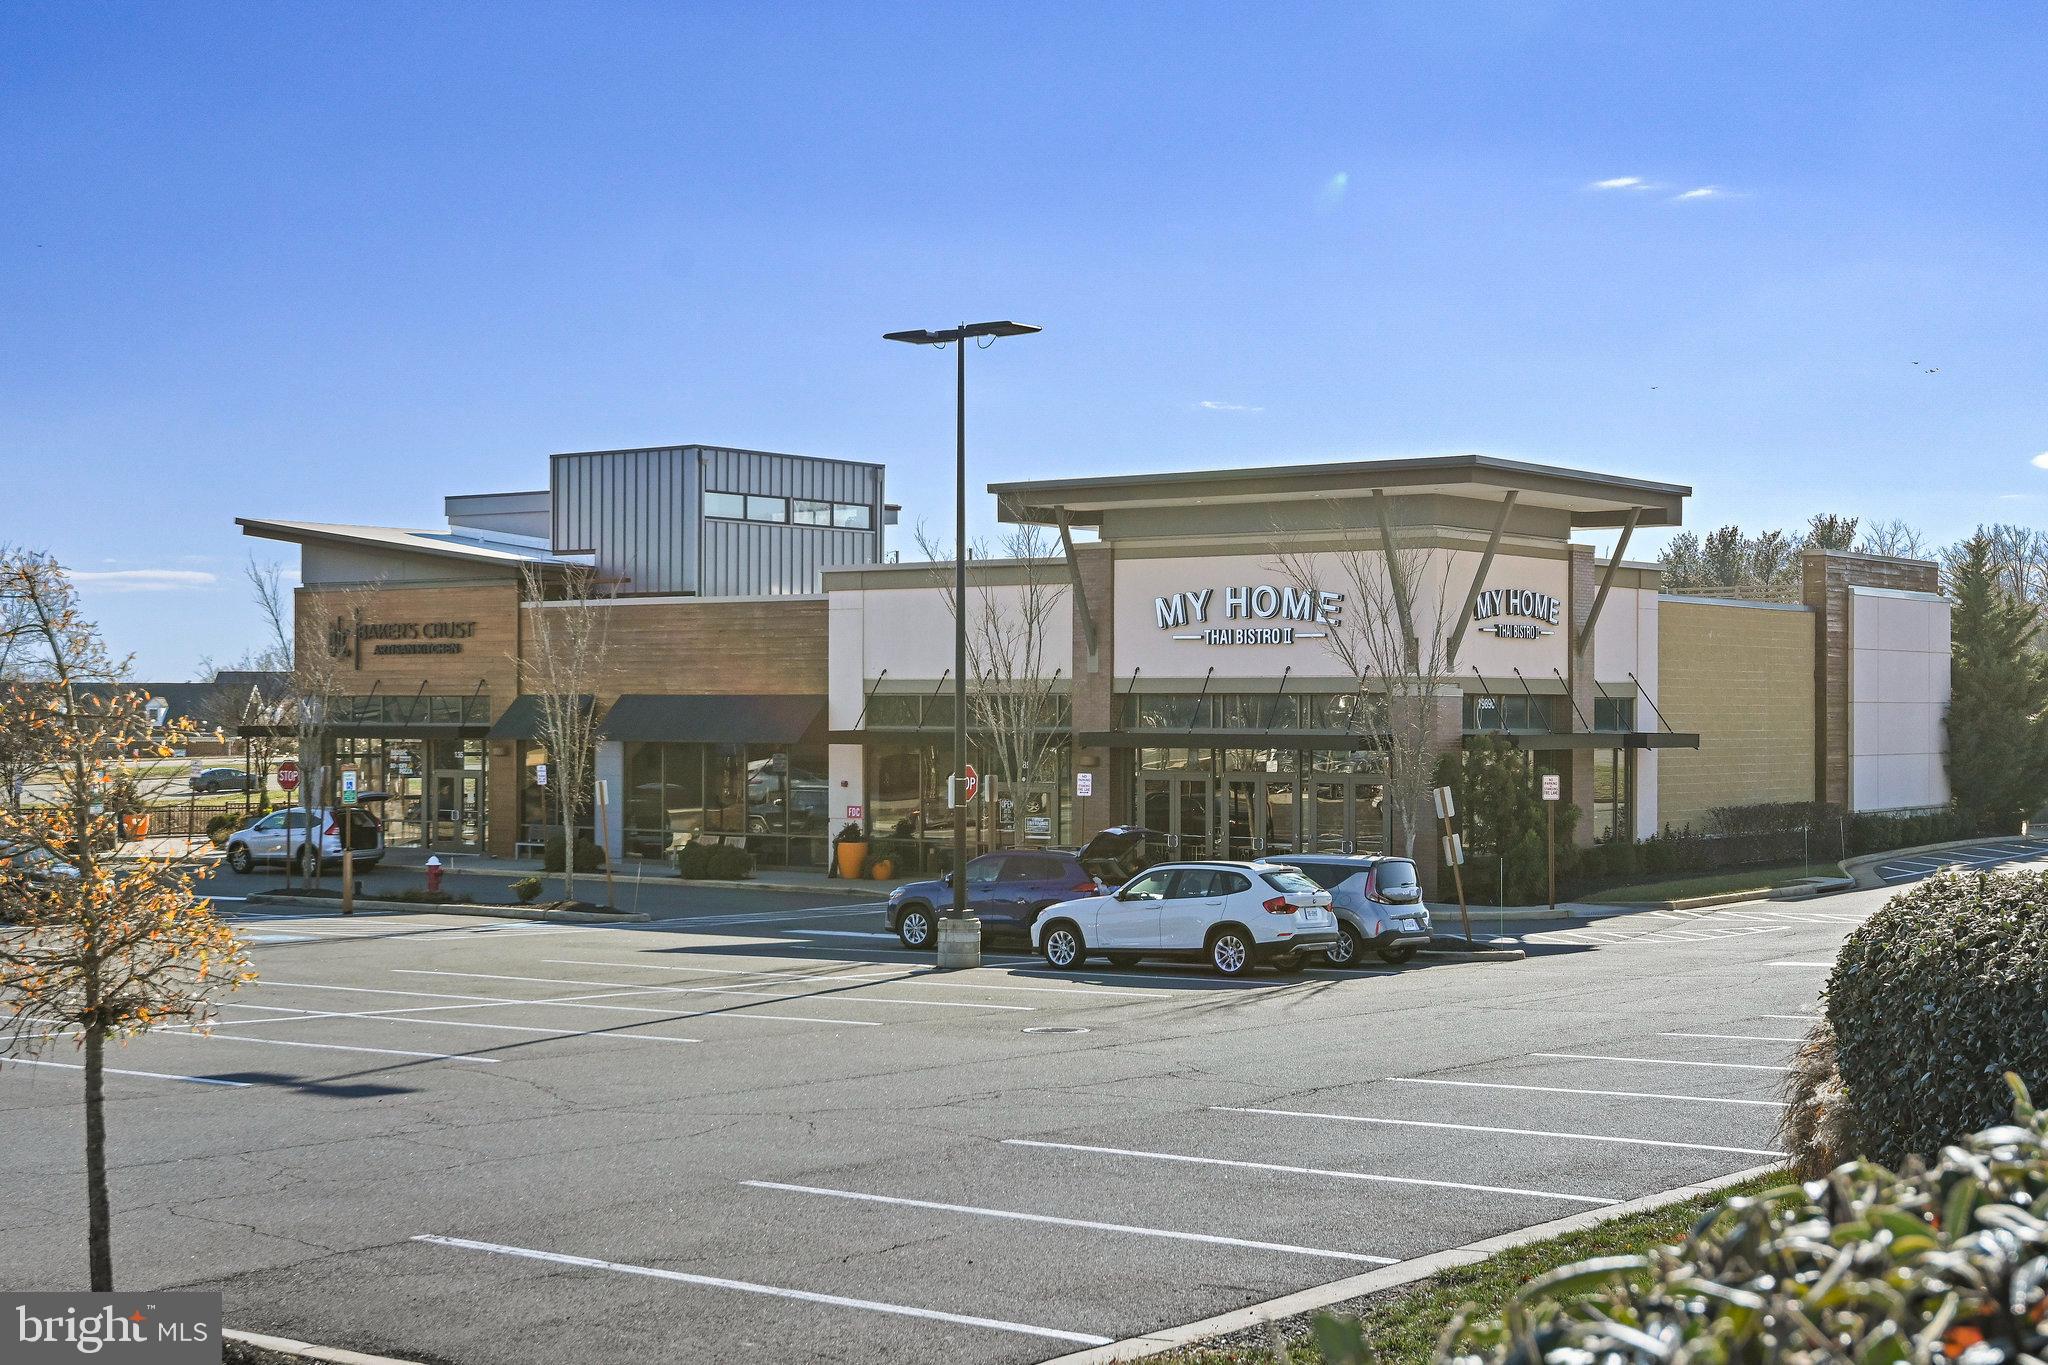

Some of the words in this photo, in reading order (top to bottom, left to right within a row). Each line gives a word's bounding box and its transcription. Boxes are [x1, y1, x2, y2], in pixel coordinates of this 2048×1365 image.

[1155, 588, 1213, 630] MY
[1225, 585, 1345, 627] HOME
[1475, 589, 1503, 620] MY
[1507, 589, 1560, 626] HOME
[422, 621, 476, 638] CRUST
[1204, 628, 1232, 645] THAI
[1236, 628, 1280, 645] BISTRO
[1283, 627, 1293, 644] II
[1498, 624, 1512, 638] THAI
[1514, 625, 1535, 639] BISTRO
[279, 770, 299, 781] STOP
[848, 807, 861, 817] FDC
